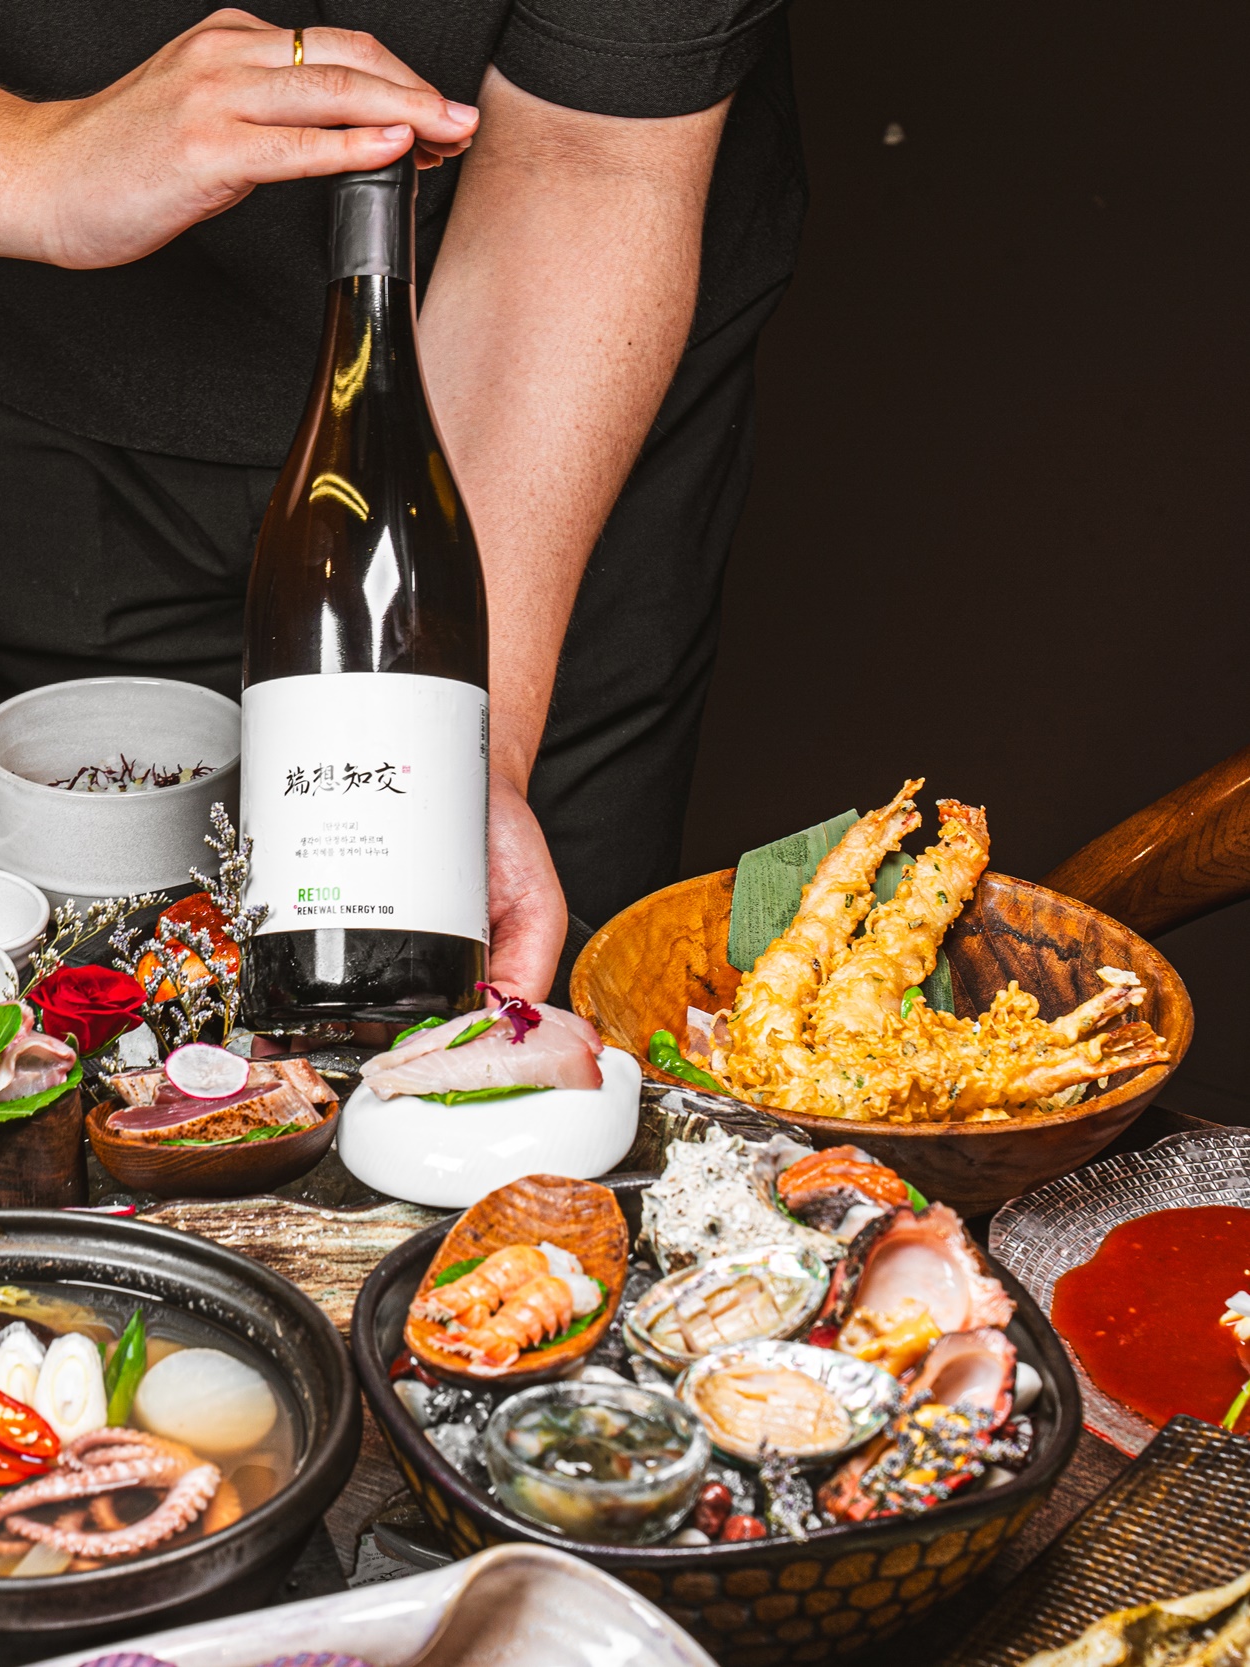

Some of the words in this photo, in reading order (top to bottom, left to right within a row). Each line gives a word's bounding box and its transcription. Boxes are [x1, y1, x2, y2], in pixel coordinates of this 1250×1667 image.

[298, 886, 341, 902] RE100
[297, 905, 338, 915] RENEWAL
[340, 905, 376, 914] ENERGY
[378, 905, 394, 915] 100
